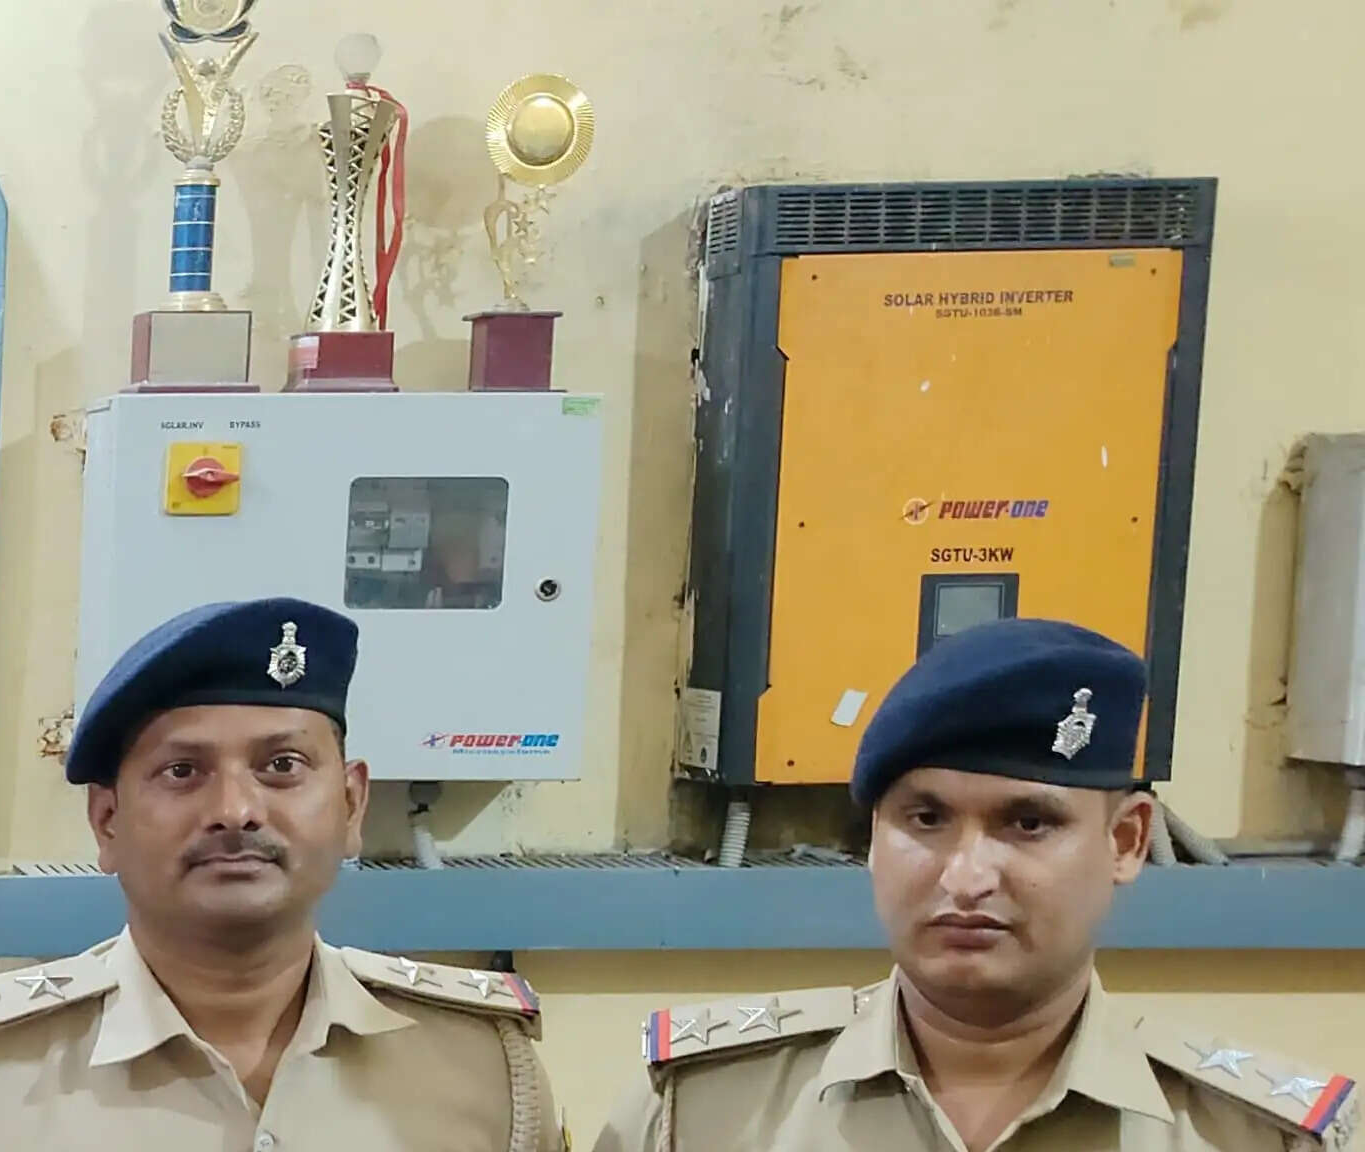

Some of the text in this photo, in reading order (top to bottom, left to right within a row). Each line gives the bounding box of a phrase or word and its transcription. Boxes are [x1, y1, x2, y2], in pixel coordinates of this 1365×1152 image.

[884, 290, 1073, 306] SOLAR HYBRID INVERTER
[229, 420, 261, 429] BYPASS
[931, 547, 1014, 562] SGTU-3KW
